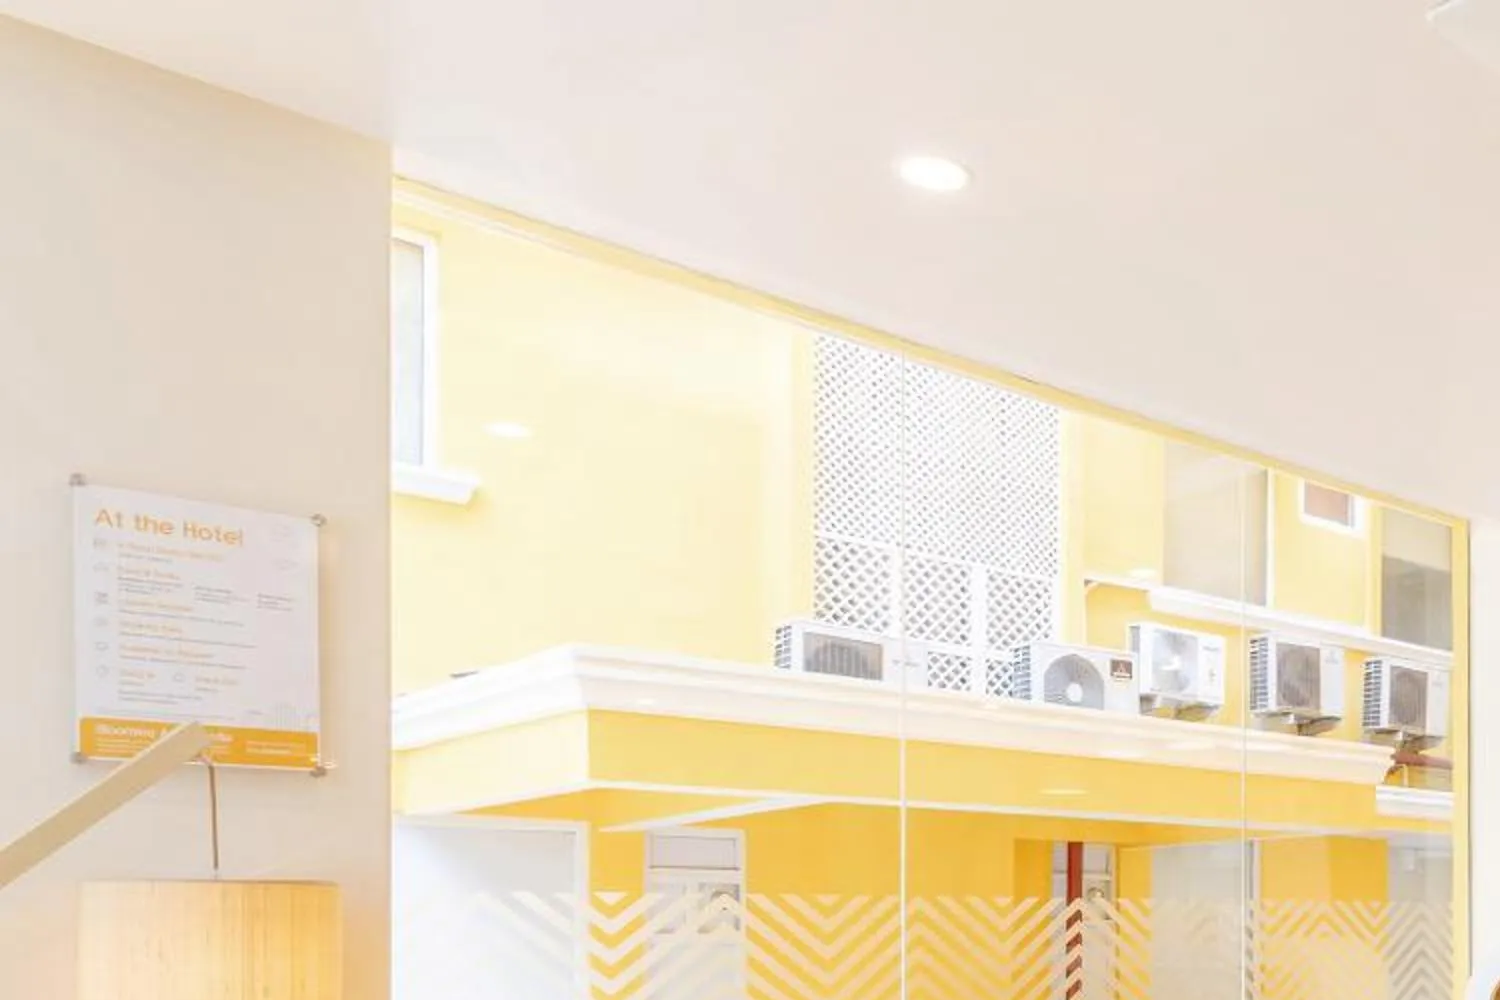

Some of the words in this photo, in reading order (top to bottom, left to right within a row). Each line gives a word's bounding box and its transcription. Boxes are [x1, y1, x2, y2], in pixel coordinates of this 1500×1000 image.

[95, 508, 123, 529] At
[134, 513, 175, 536] the
[183, 519, 244, 547] Hotel
